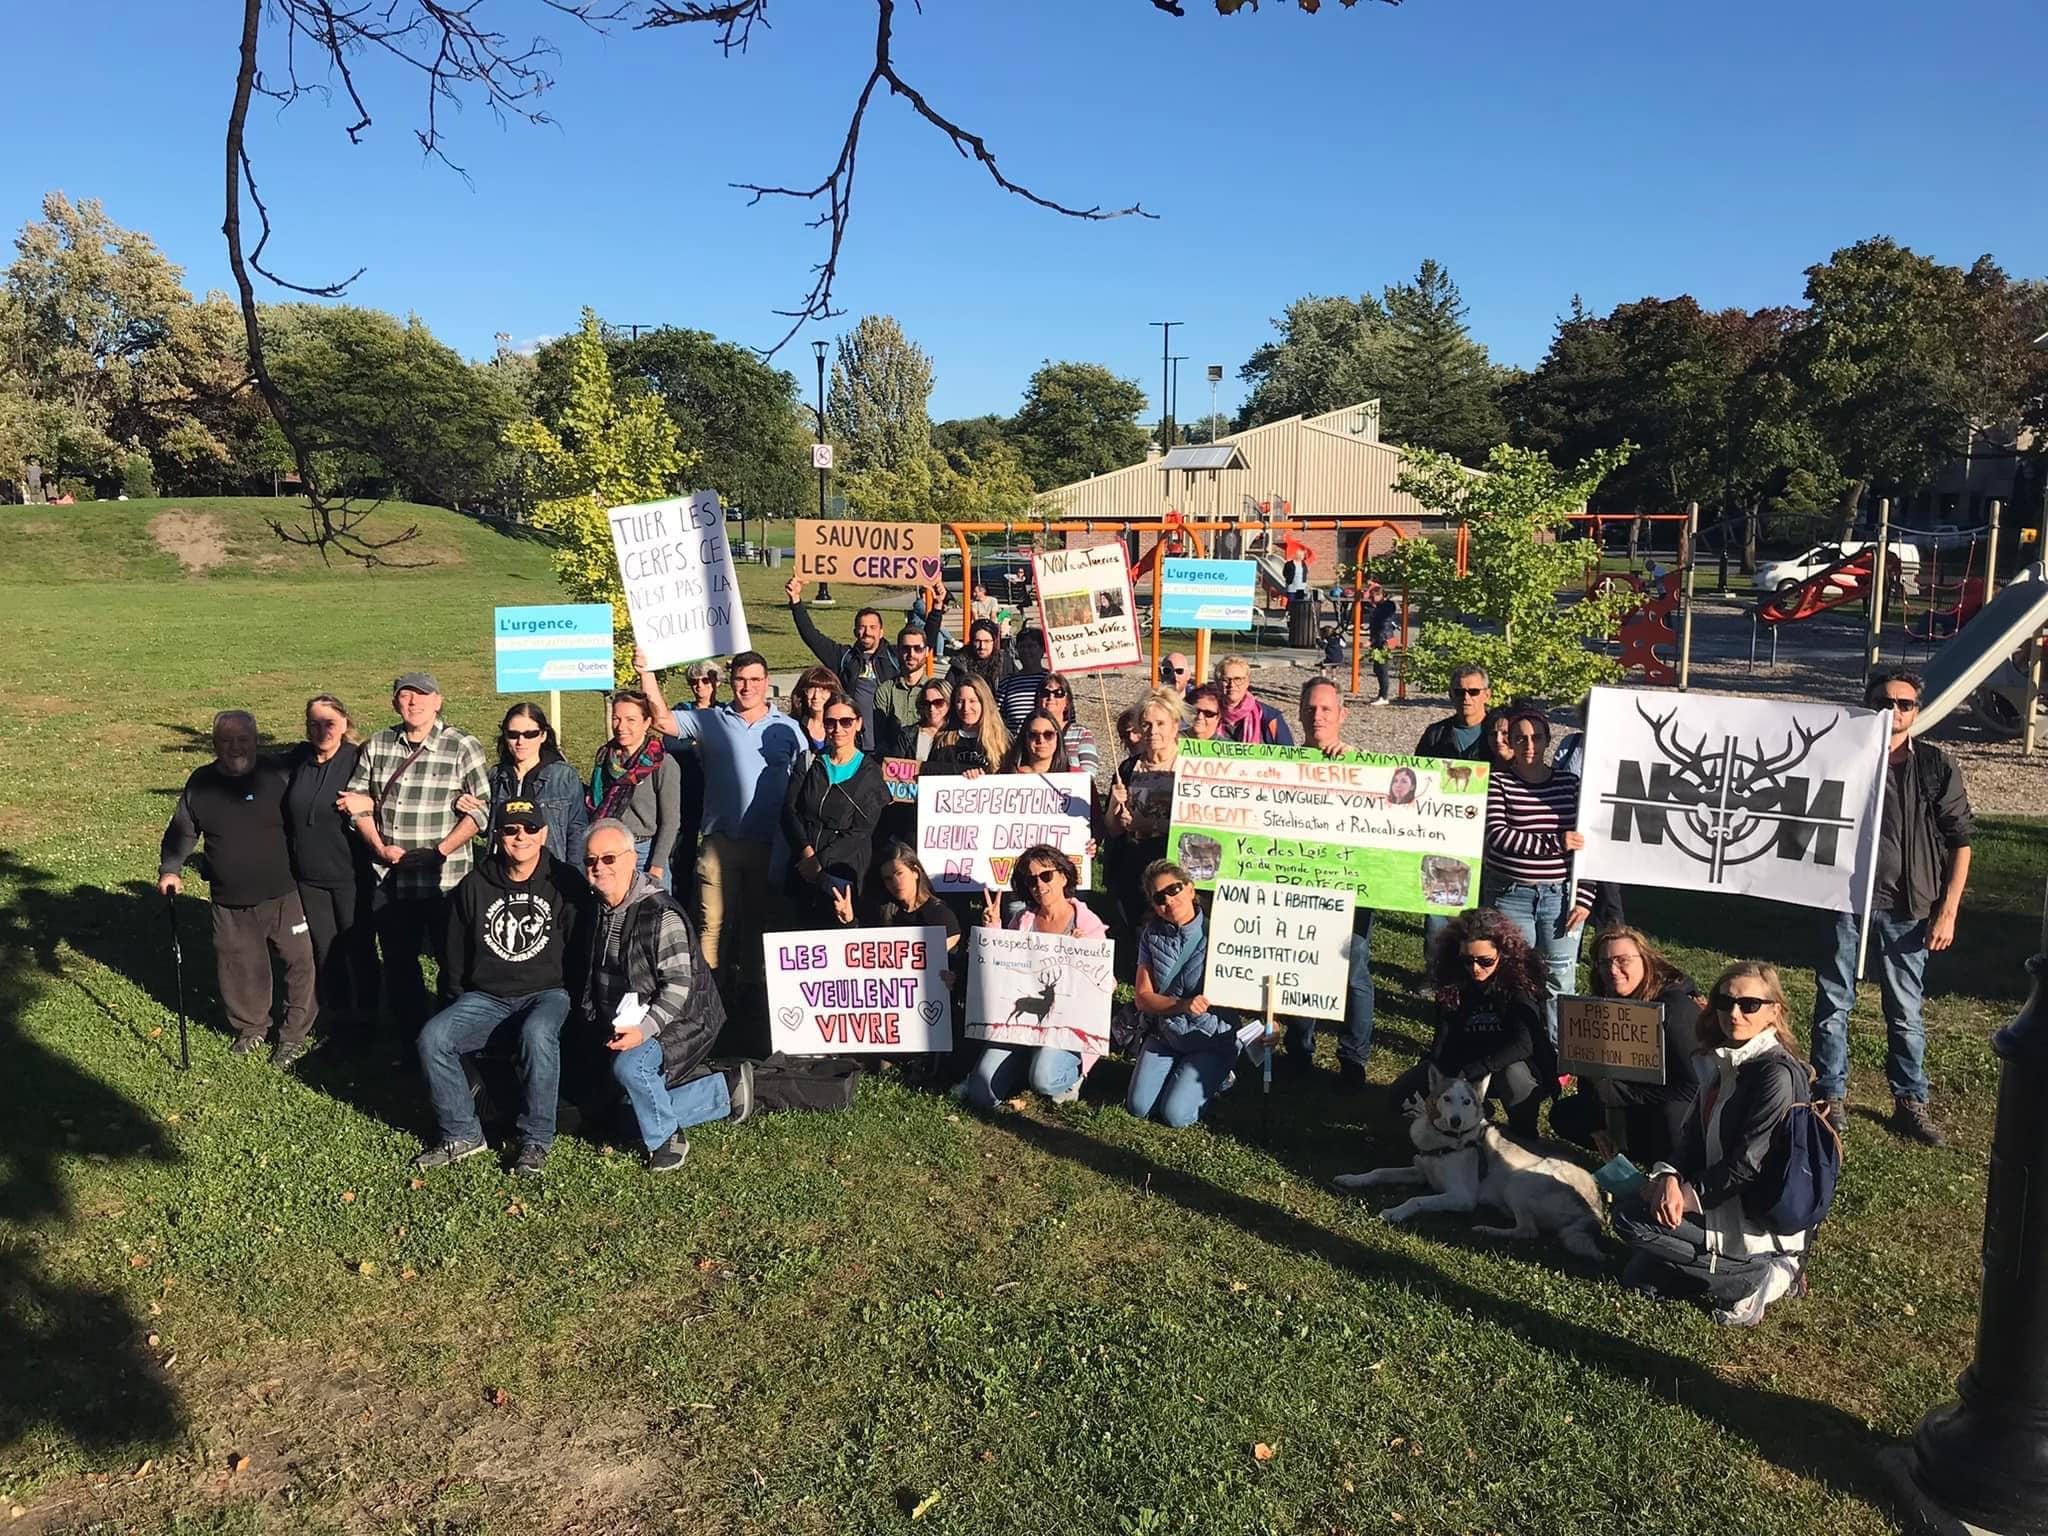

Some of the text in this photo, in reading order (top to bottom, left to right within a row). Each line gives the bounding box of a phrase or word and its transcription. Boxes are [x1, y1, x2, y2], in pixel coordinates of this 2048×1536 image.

[612, 502, 717, 545] TUER LES
[699, 536, 724, 565] CE
[815, 525, 914, 550] SAUVONS
[802, 554, 918, 579] LES CERFS
[1167, 568, 1229, 581] L'urgence,
[629, 574, 733, 611] N'EST PAS LA
[500, 619, 578, 633] L'urgence,
[646, 602, 732, 642] SOLUTION
[1180, 740, 1201, 756] AU
[1260, 743, 1275, 758] ON
[1278, 745, 1311, 760] AIME
[1354, 752, 1435, 769] ANIMAUX
[886, 761, 915, 780] OUI
[1181, 759, 1233, 776] NON
[1296, 763, 1363, 786] TUERIE
[935, 788, 1072, 814] RESPECTONS
[1178, 782, 1201, 798] LES
[1211, 784, 1250, 799] CERFS
[1272, 789, 1334, 806] LONGUEIL
[1338, 794, 1386, 811] VONT
[1415, 798, 1465, 819] VIVRE
[924, 824, 1070, 850] LEUR DROIT
[1336, 818, 1346, 832] et
[1350, 815, 1446, 840] Relocalisation
[1267, 838, 1294, 857] des
[1336, 847, 1354, 860] et
[943, 858, 974, 884] DE
[1258, 858, 1271, 871] du
[1216, 884, 1250, 904] NON
[1273, 890, 1345, 912] L'ABATTAGE
[1233, 915, 1261, 936] OUI
[1298, 924, 1317, 941] LA
[780, 941, 928, 970] LES CERFS
[979, 933, 1111, 958] Le respect des chevreuils
[1216, 942, 1319, 966] COHABITATION
[1040, 954, 1071, 967] mon
[1215, 964, 1300, 987] AVEC LES
[800, 977, 918, 1009] VEULENT
[1281, 989, 1339, 1011] ANIMAUX
[1584, 1003, 1632, 1021] PAS DE
[815, 1012, 901, 1044] VIVRE
[1569, 1017, 1649, 1044] MASSACRE
[1601, 1048, 1622, 1065] MON
[1630, 1051, 1659, 1068] PARC
